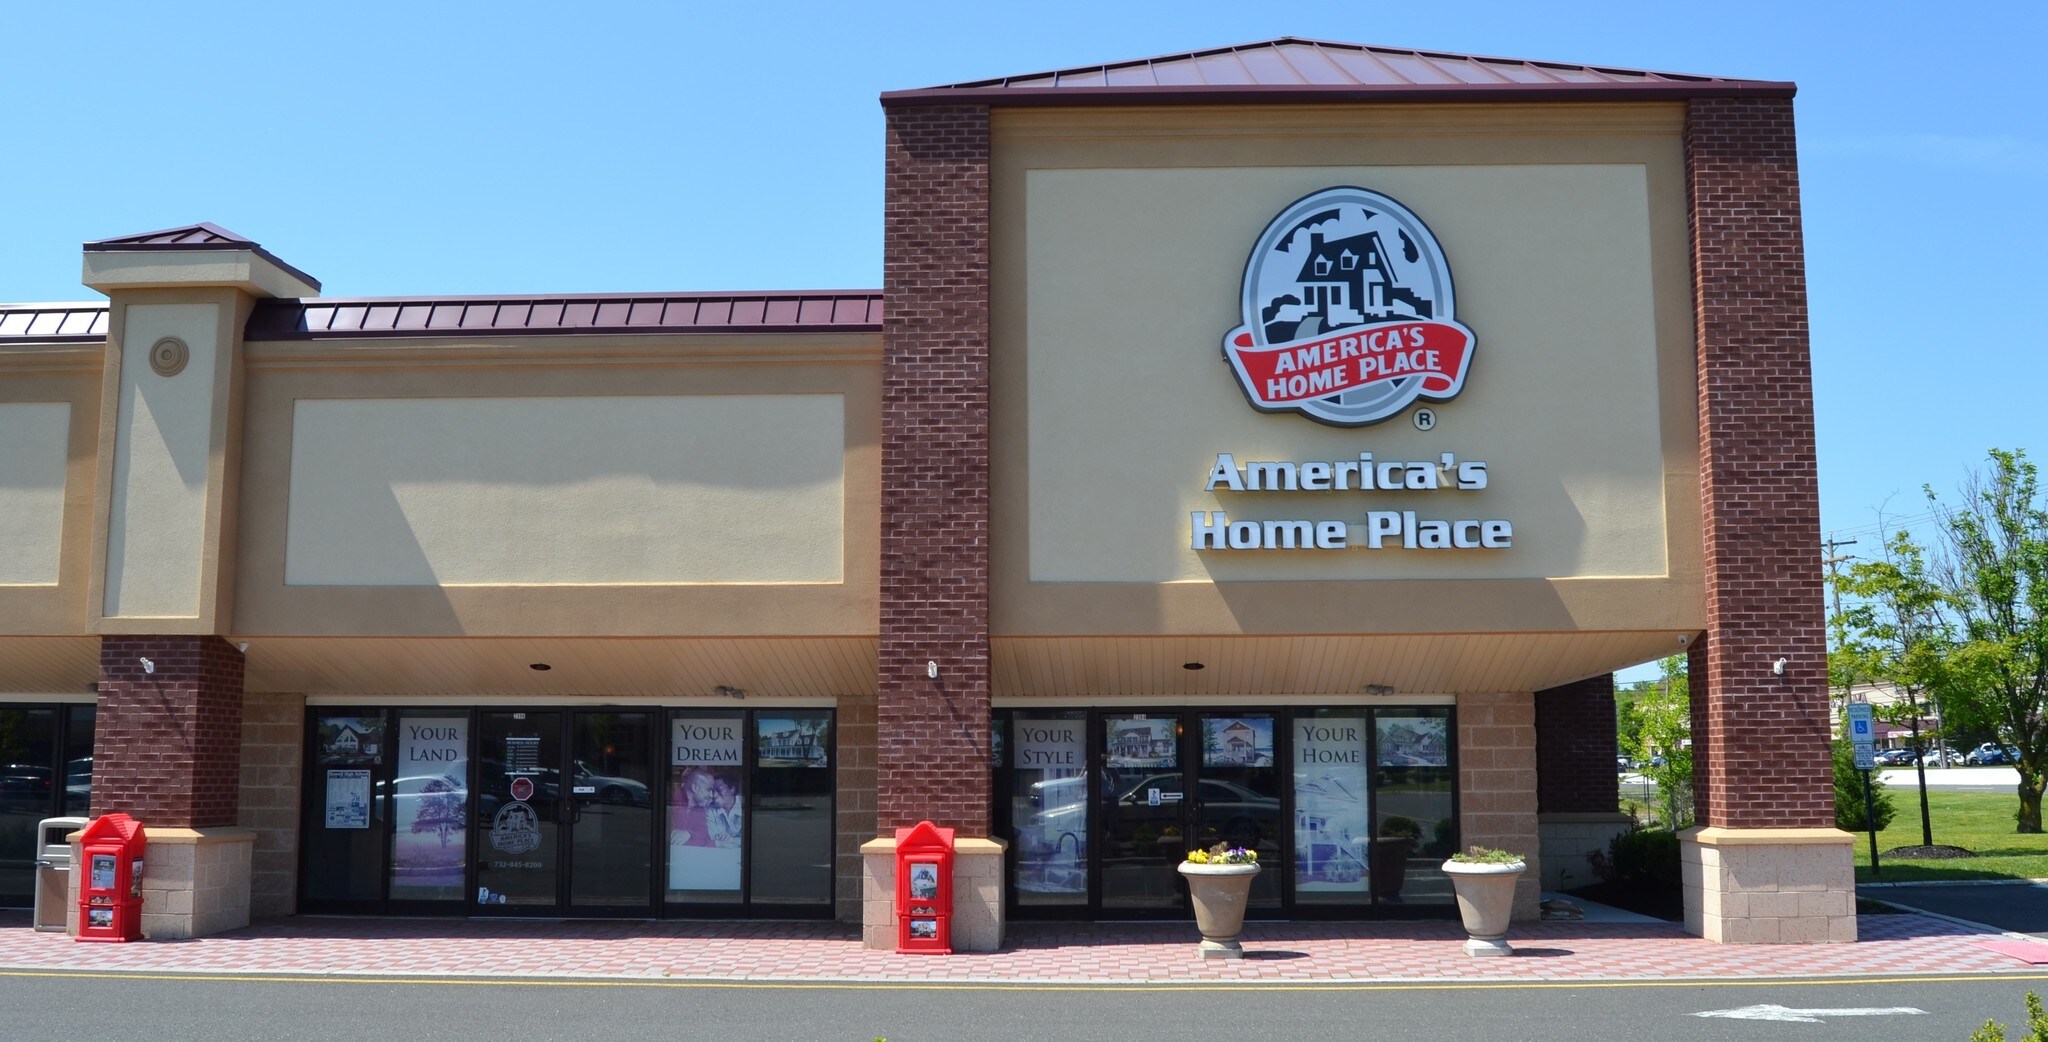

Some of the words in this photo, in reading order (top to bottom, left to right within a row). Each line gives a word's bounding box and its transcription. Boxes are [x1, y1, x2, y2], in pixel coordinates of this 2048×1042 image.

[1274, 327, 1425, 374] AMERICA'S
[1266, 365, 1349, 400] HOME
[1359, 350, 1442, 380] PLACE
[1204, 452, 1489, 492] America's
[1190, 511, 1348, 551] Home
[1366, 511, 1514, 551] Place
[409, 725, 458, 740] YOUR
[680, 725, 734, 740] YOUR
[1022, 727, 1074, 742] YOUR
[1302, 726, 1358, 741] YOUR
[410, 747, 457, 761] LAND
[677, 746, 738, 761] DREAM
[1023, 749, 1073, 764] STYLE
[1302, 748, 1359, 763] HOME
